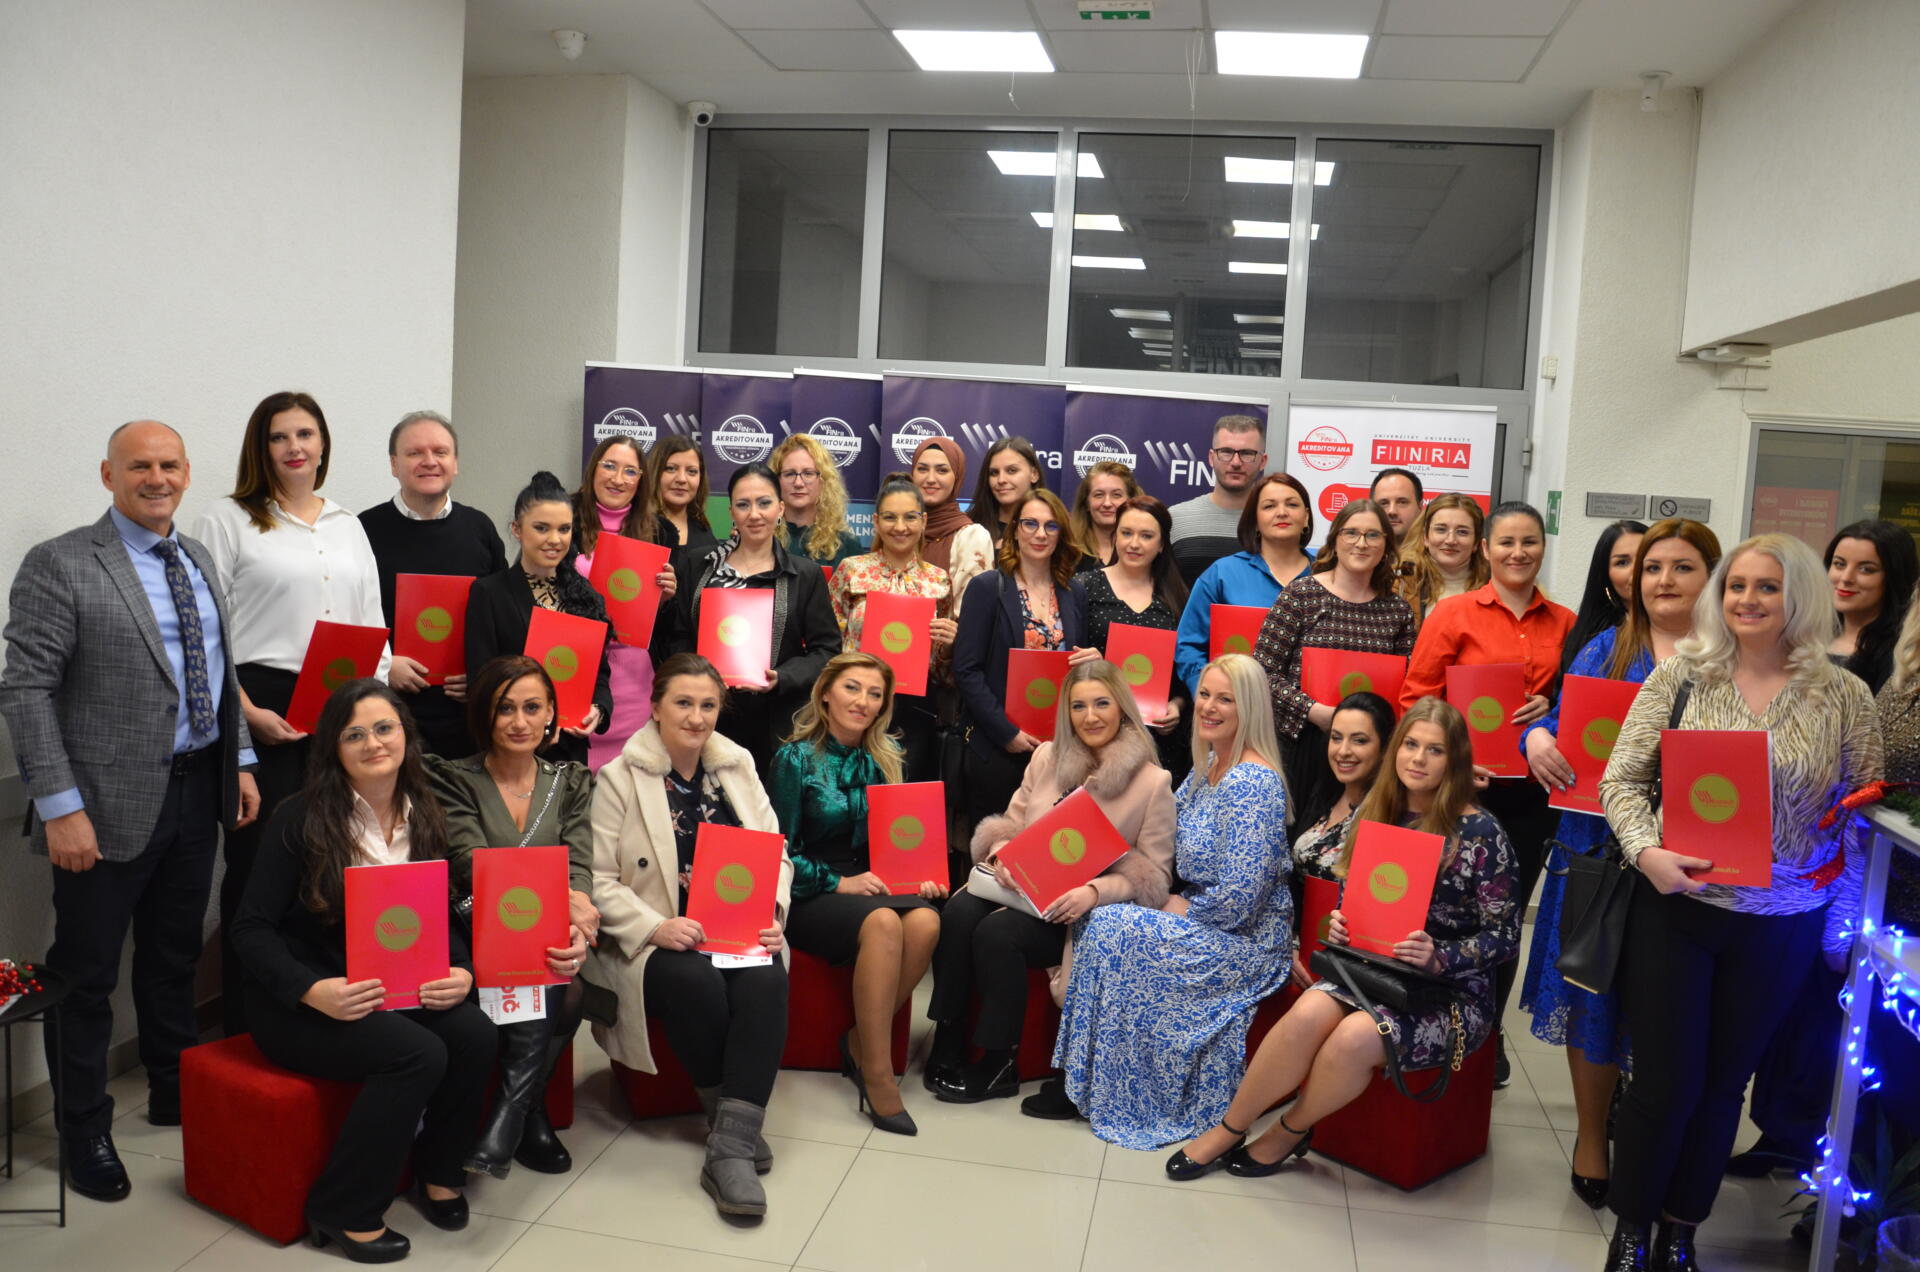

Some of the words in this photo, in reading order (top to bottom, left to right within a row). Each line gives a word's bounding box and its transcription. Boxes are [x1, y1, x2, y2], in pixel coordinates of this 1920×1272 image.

[597, 428, 653, 437] AKREDITOVANA
[715, 435, 770, 444] AKREDITOVANA
[1170, 459, 1216, 487] FIN
[846, 513, 874, 524] MEN
